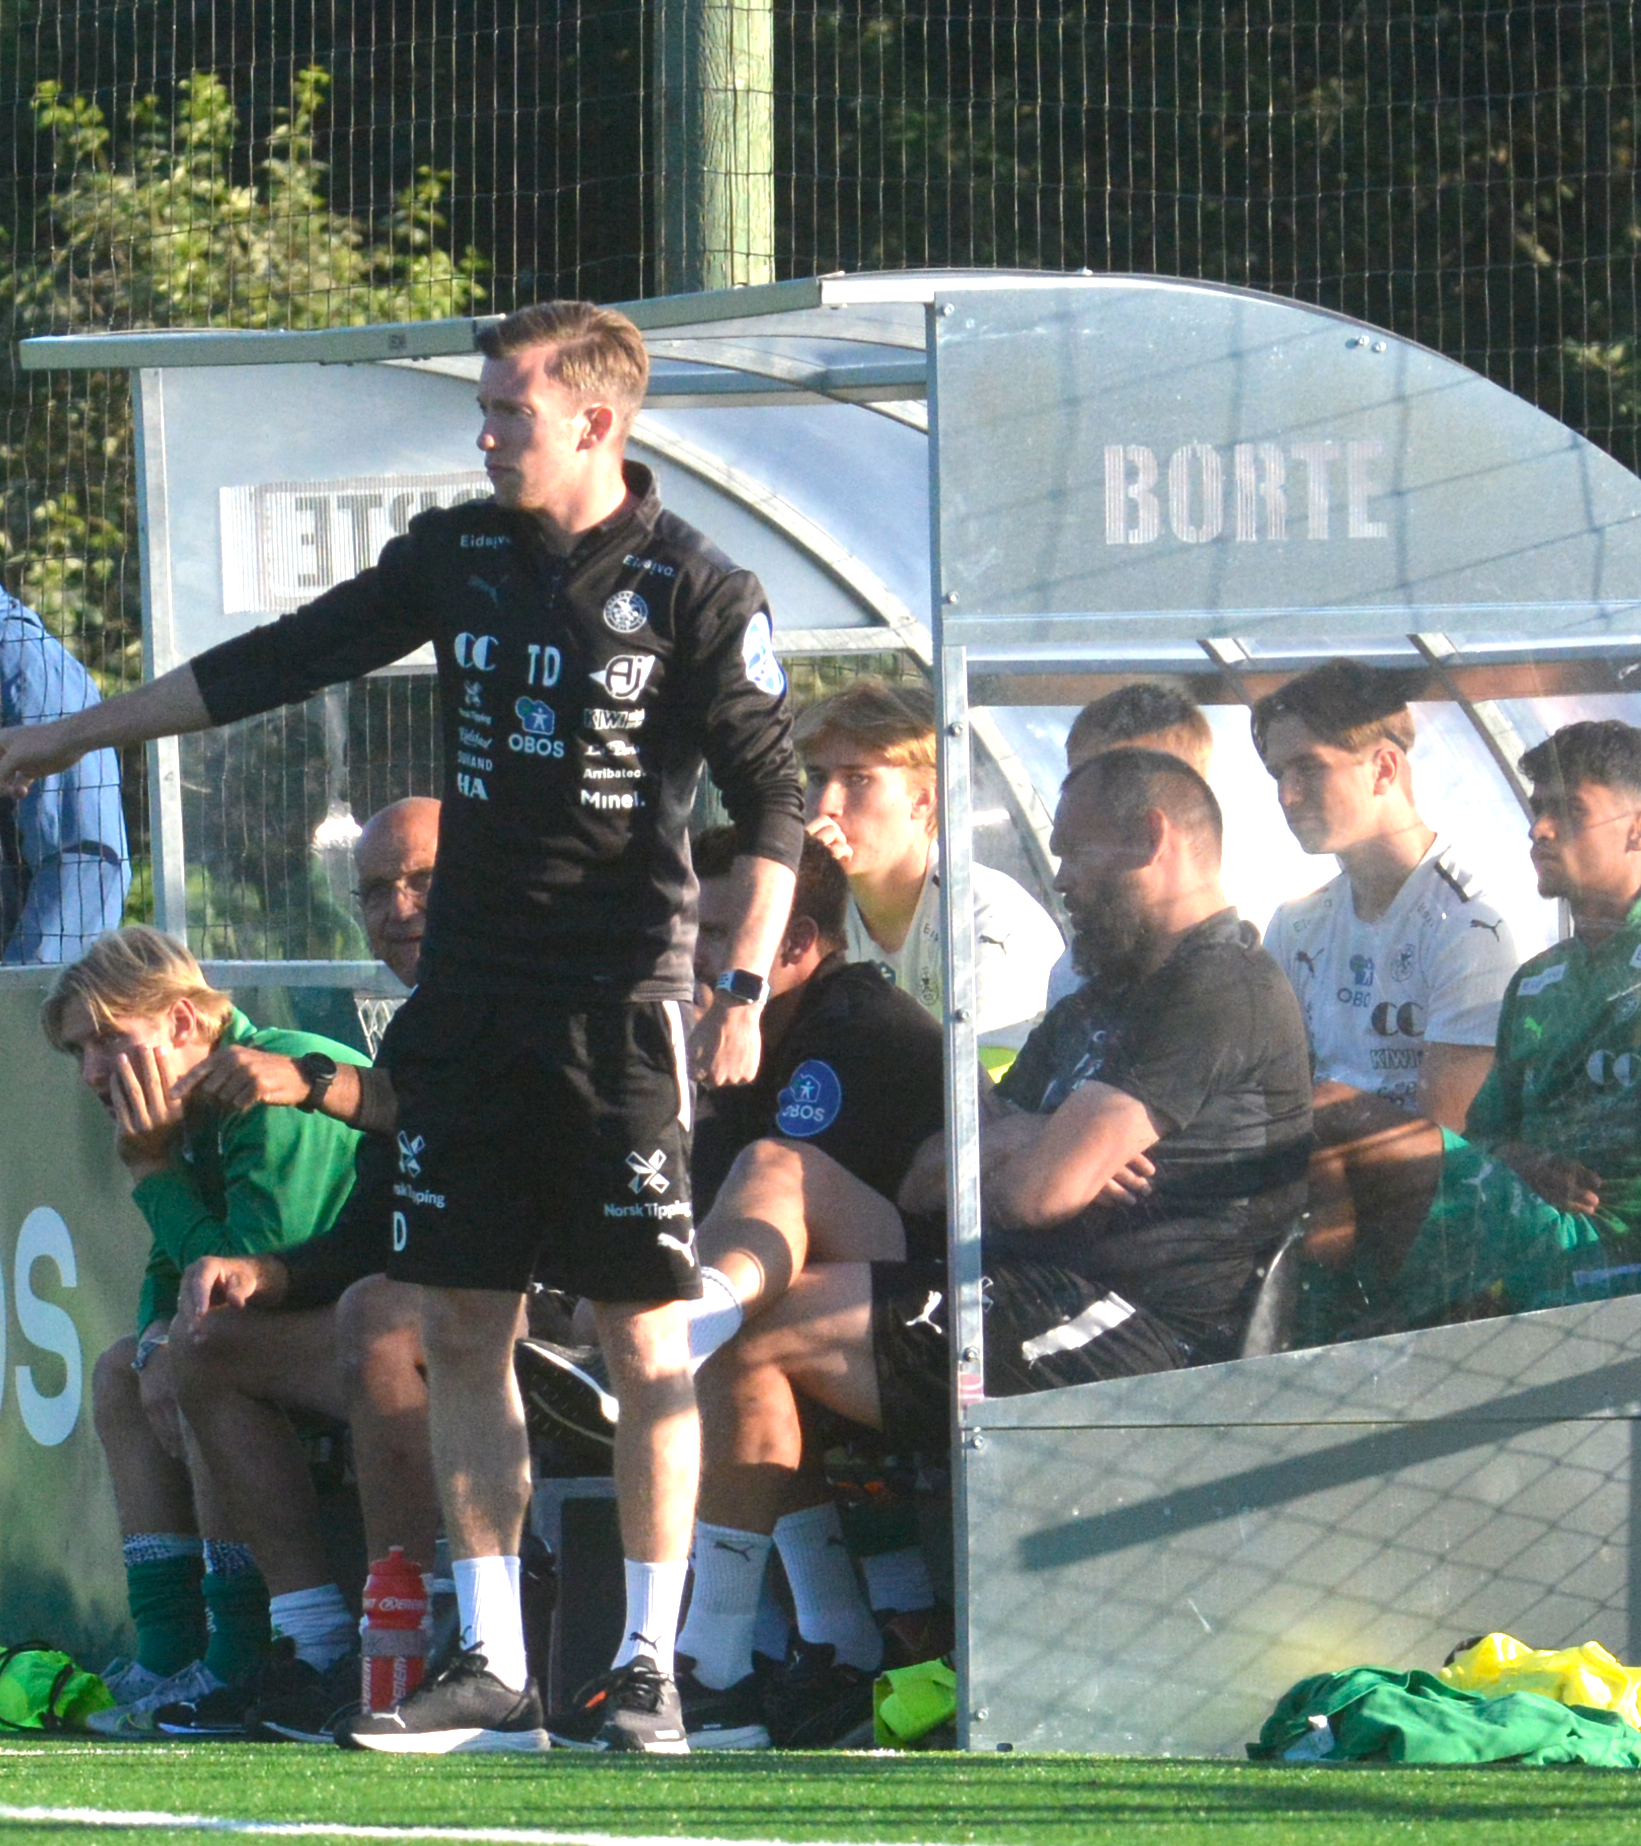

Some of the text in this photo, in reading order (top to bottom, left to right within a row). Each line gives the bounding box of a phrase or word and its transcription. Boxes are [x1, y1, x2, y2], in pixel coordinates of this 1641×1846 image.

[1104, 442, 1388, 545] BORTE
[528, 643, 561, 687] TD
[509, 734, 565, 759] OBOS
[604, 1204, 643, 1217] Norsk
